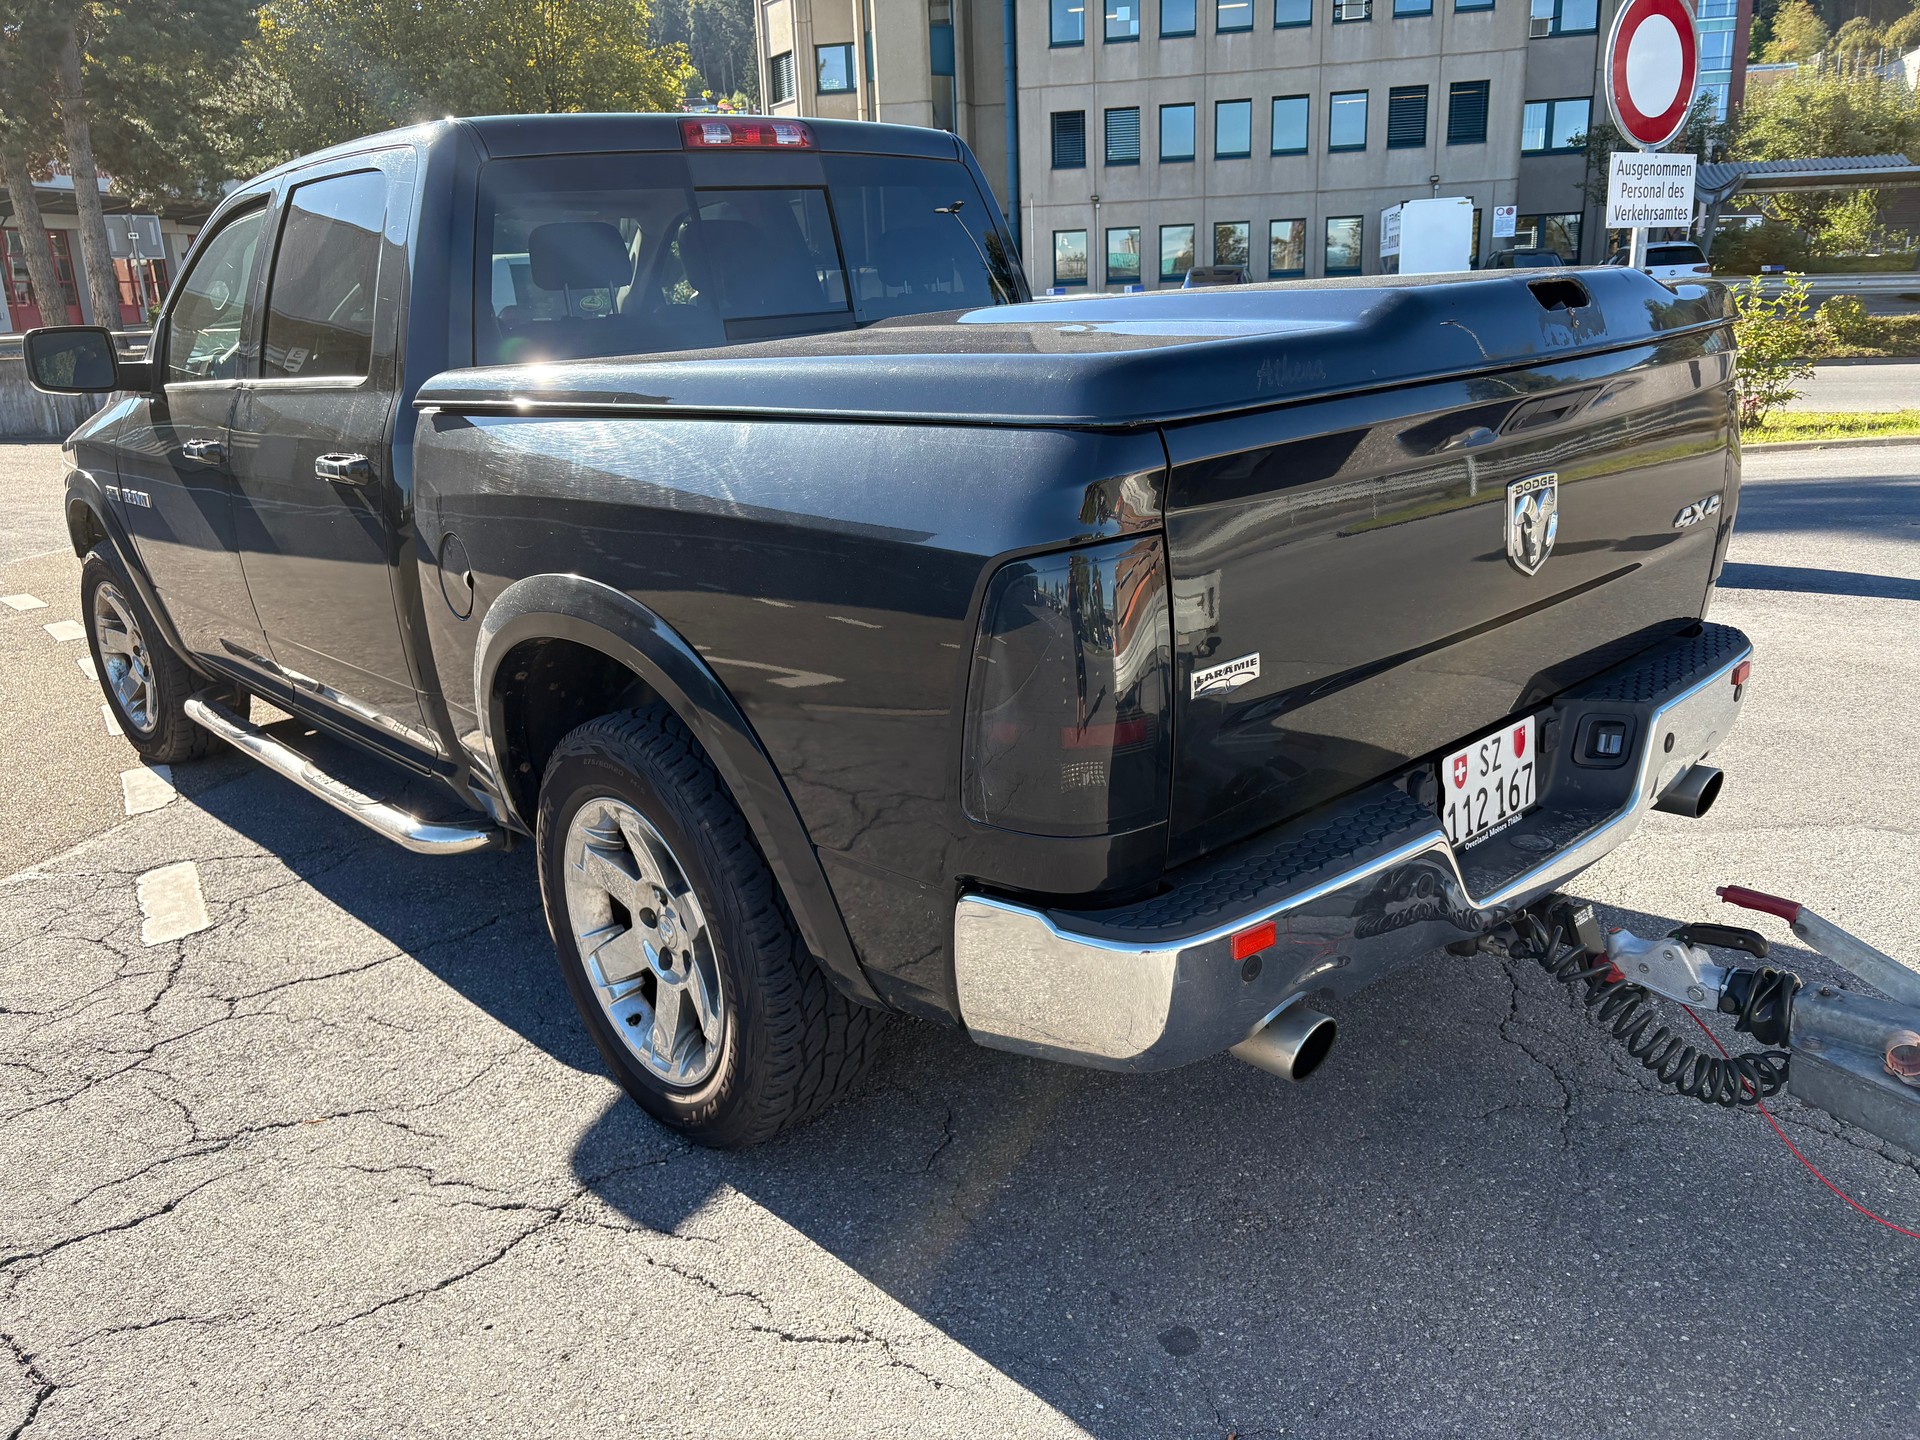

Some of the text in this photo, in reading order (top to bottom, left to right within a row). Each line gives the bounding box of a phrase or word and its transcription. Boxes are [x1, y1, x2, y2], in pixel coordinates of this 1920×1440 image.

[1616, 159, 1692, 180] Ausgenommen
[1620, 181, 1685, 199] Personal des
[1614, 203, 1689, 221] Verkehrsamtes
[1515, 475, 1555, 494] DODGE
[1194, 657, 1258, 691] LARAMIE
[1480, 736, 1502, 777] SZ
[1447, 761, 1533, 846] 112 167
